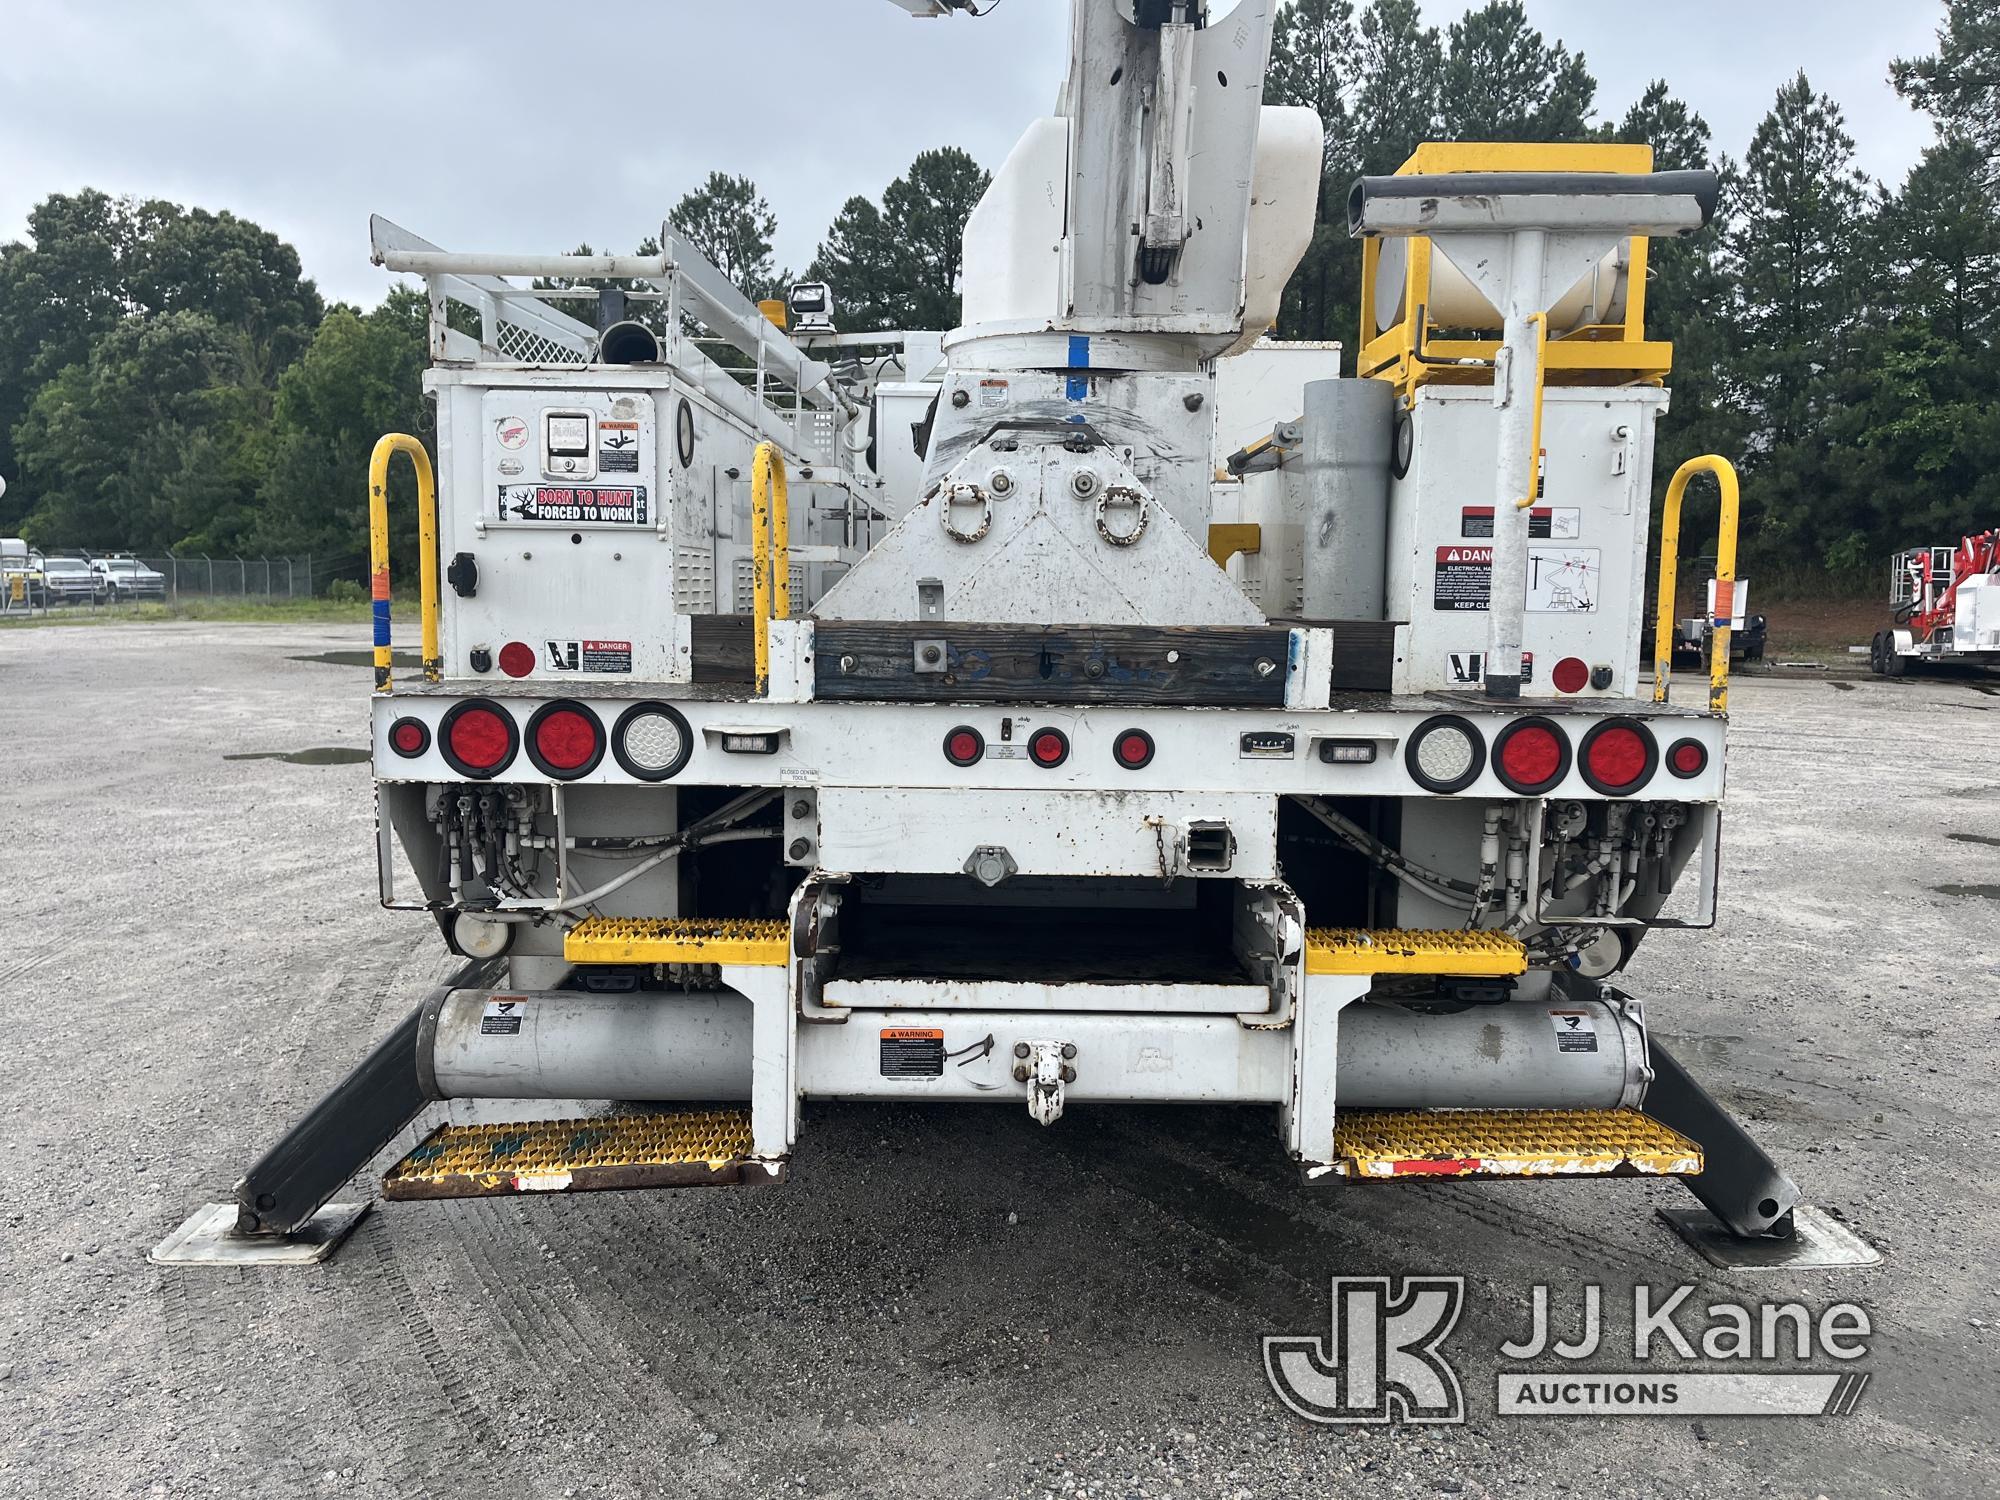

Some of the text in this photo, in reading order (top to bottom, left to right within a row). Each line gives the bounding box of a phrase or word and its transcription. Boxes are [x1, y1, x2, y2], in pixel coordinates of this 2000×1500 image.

[538, 488, 633, 506] BORN TO HUNT
[538, 506, 633, 521] FORCED TO WORK
